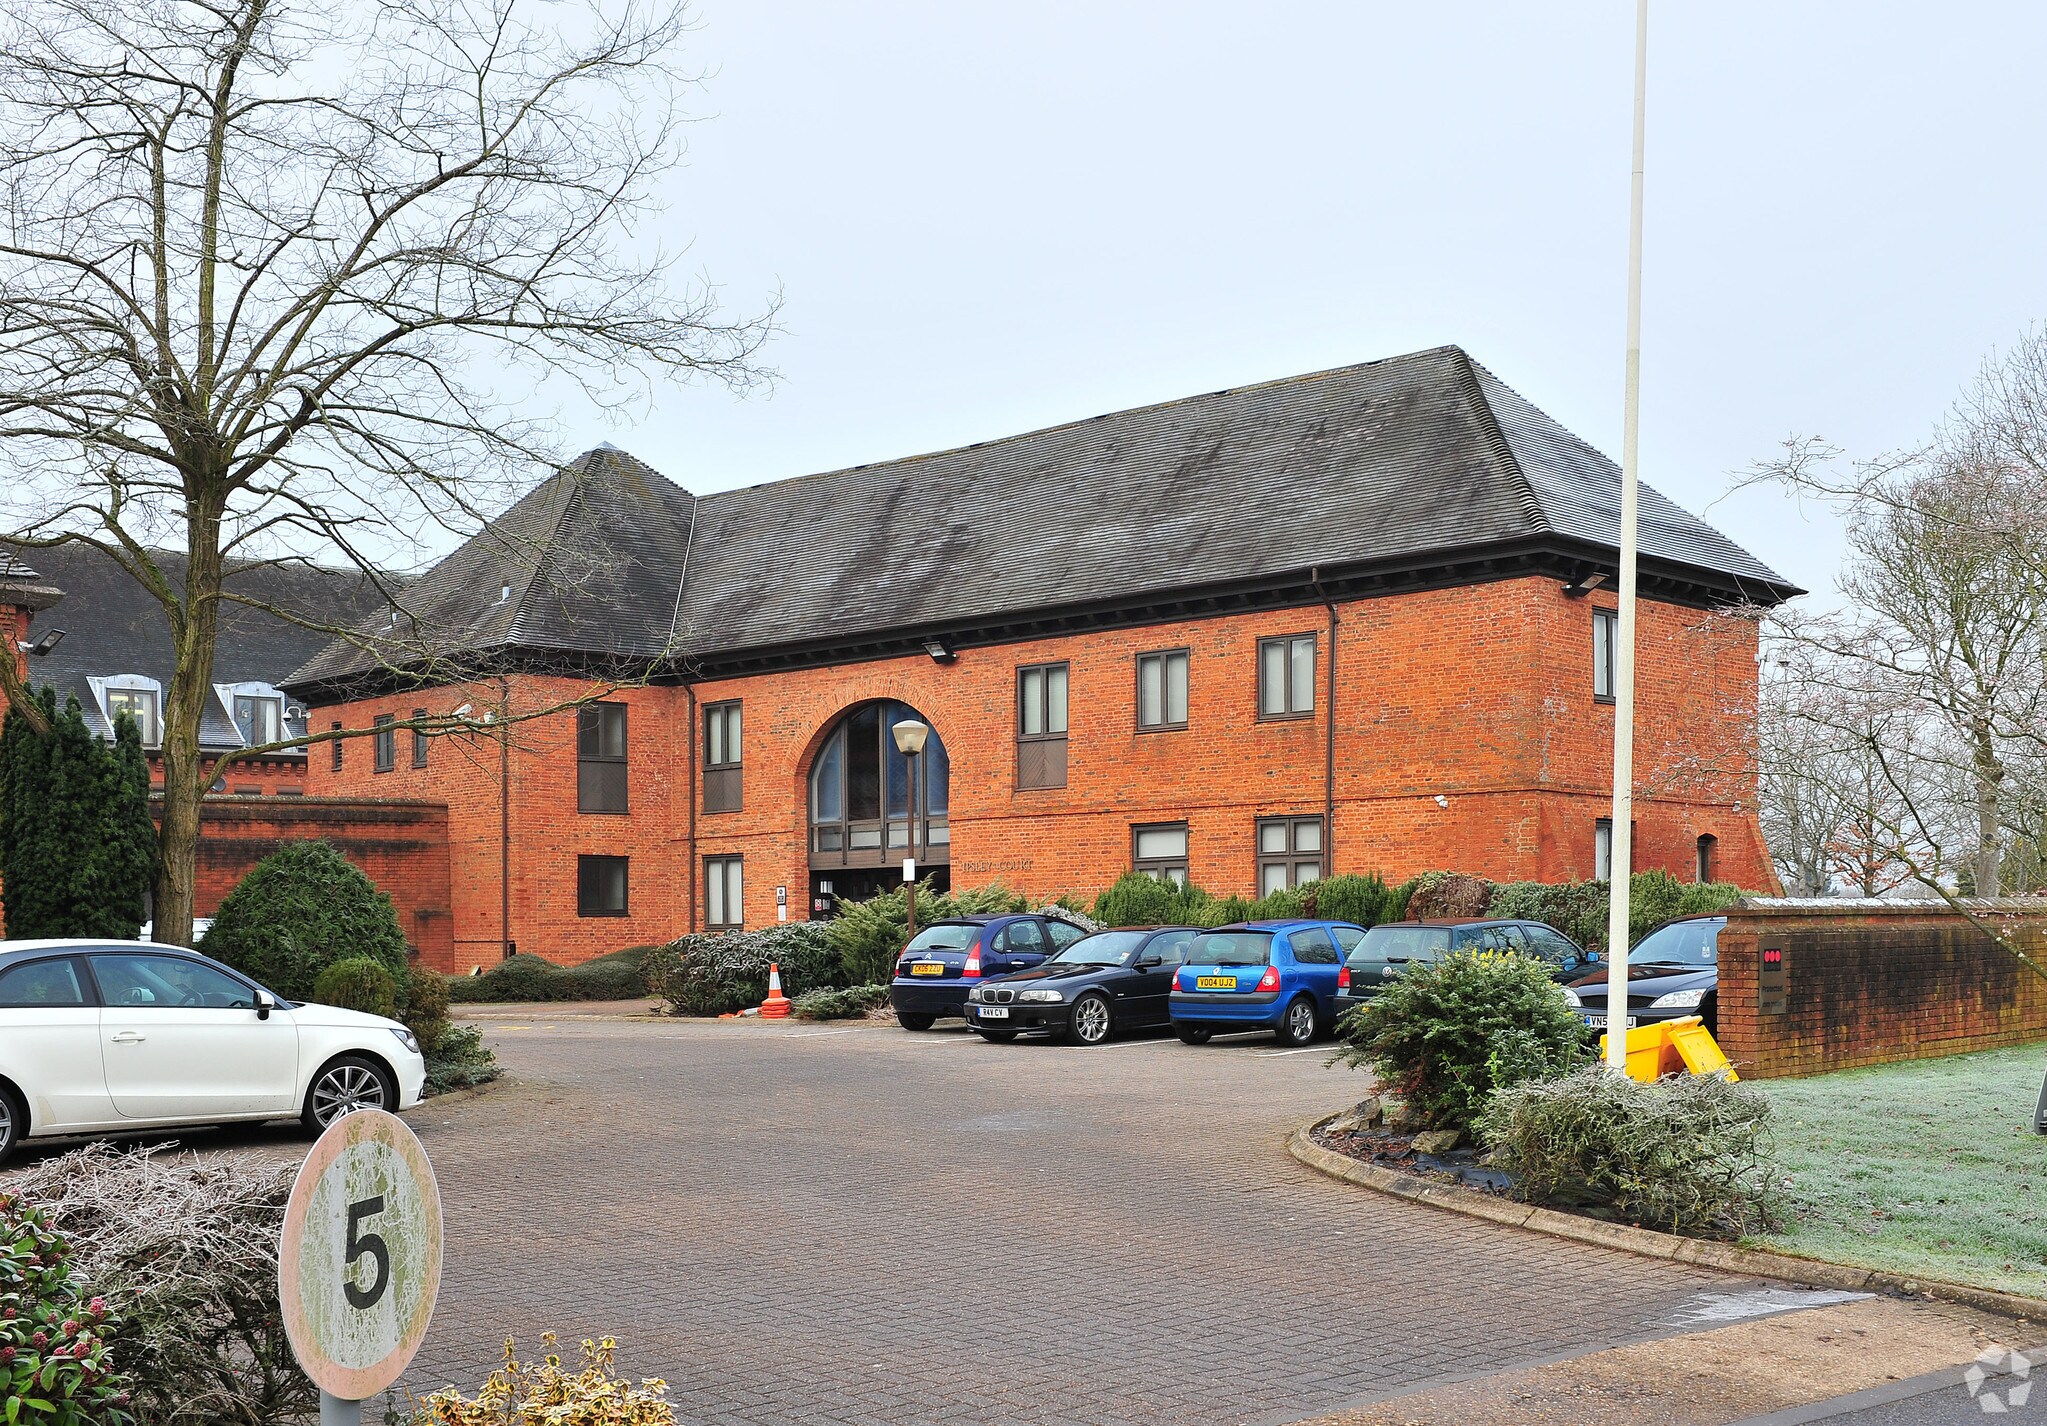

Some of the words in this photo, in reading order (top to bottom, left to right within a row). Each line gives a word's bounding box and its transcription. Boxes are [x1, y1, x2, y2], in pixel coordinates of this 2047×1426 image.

[999, 860, 1033, 872] COURT
[1219, 978, 1234, 987] UJZ
[343, 1195, 389, 1310] 5
